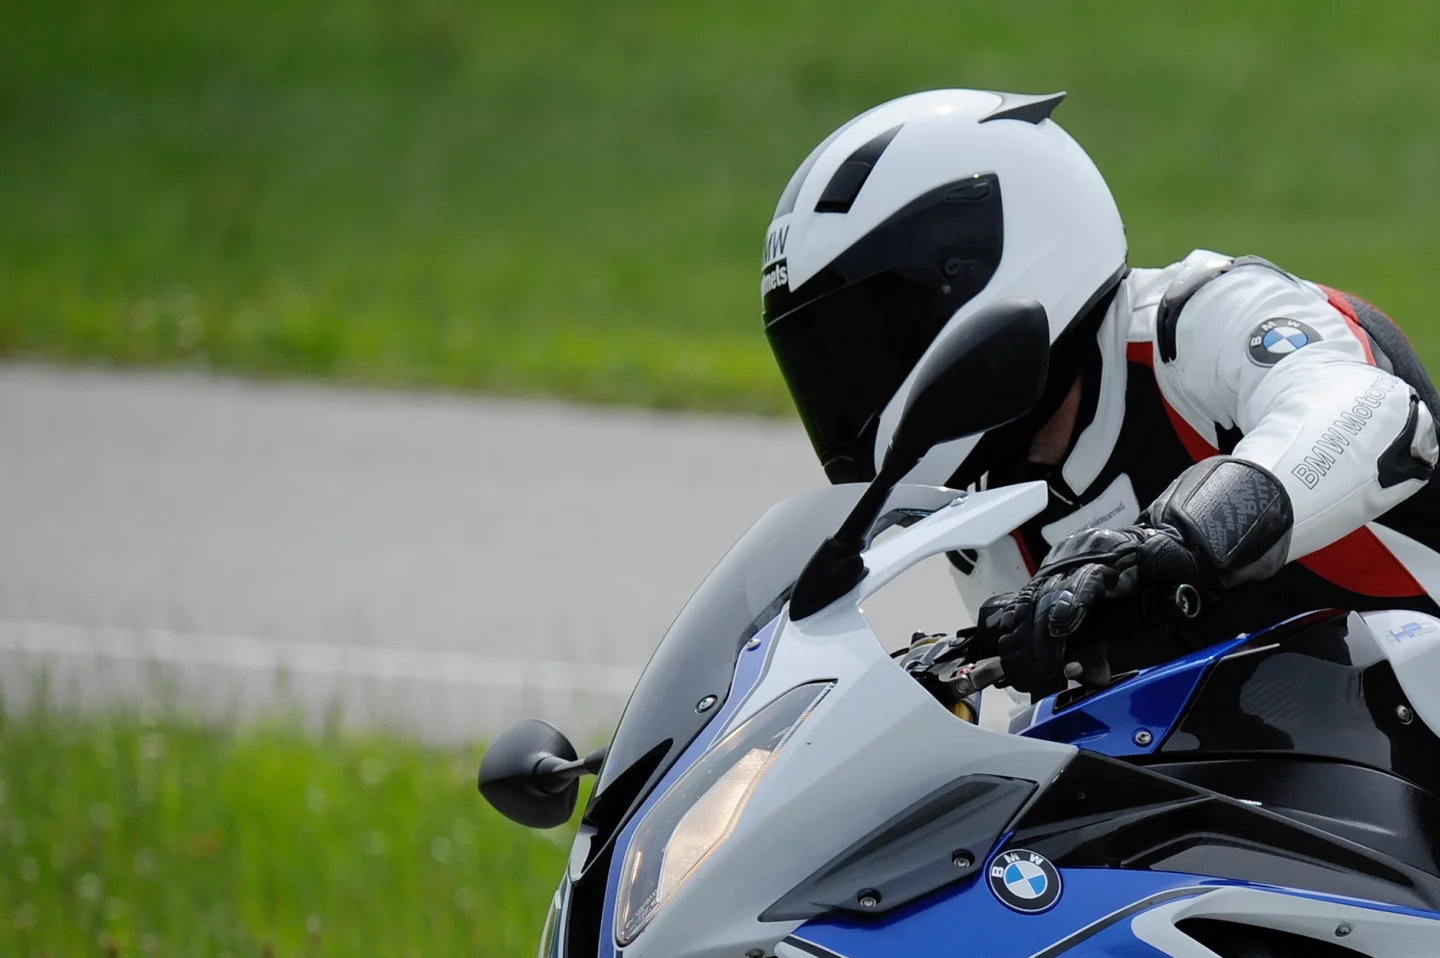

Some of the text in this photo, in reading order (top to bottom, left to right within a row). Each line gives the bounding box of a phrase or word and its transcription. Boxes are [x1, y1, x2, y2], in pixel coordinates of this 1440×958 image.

[1250, 320, 1301, 347] BMW
[1291, 427, 1350, 490] BMW
[991, 852, 1044, 878] BMW
